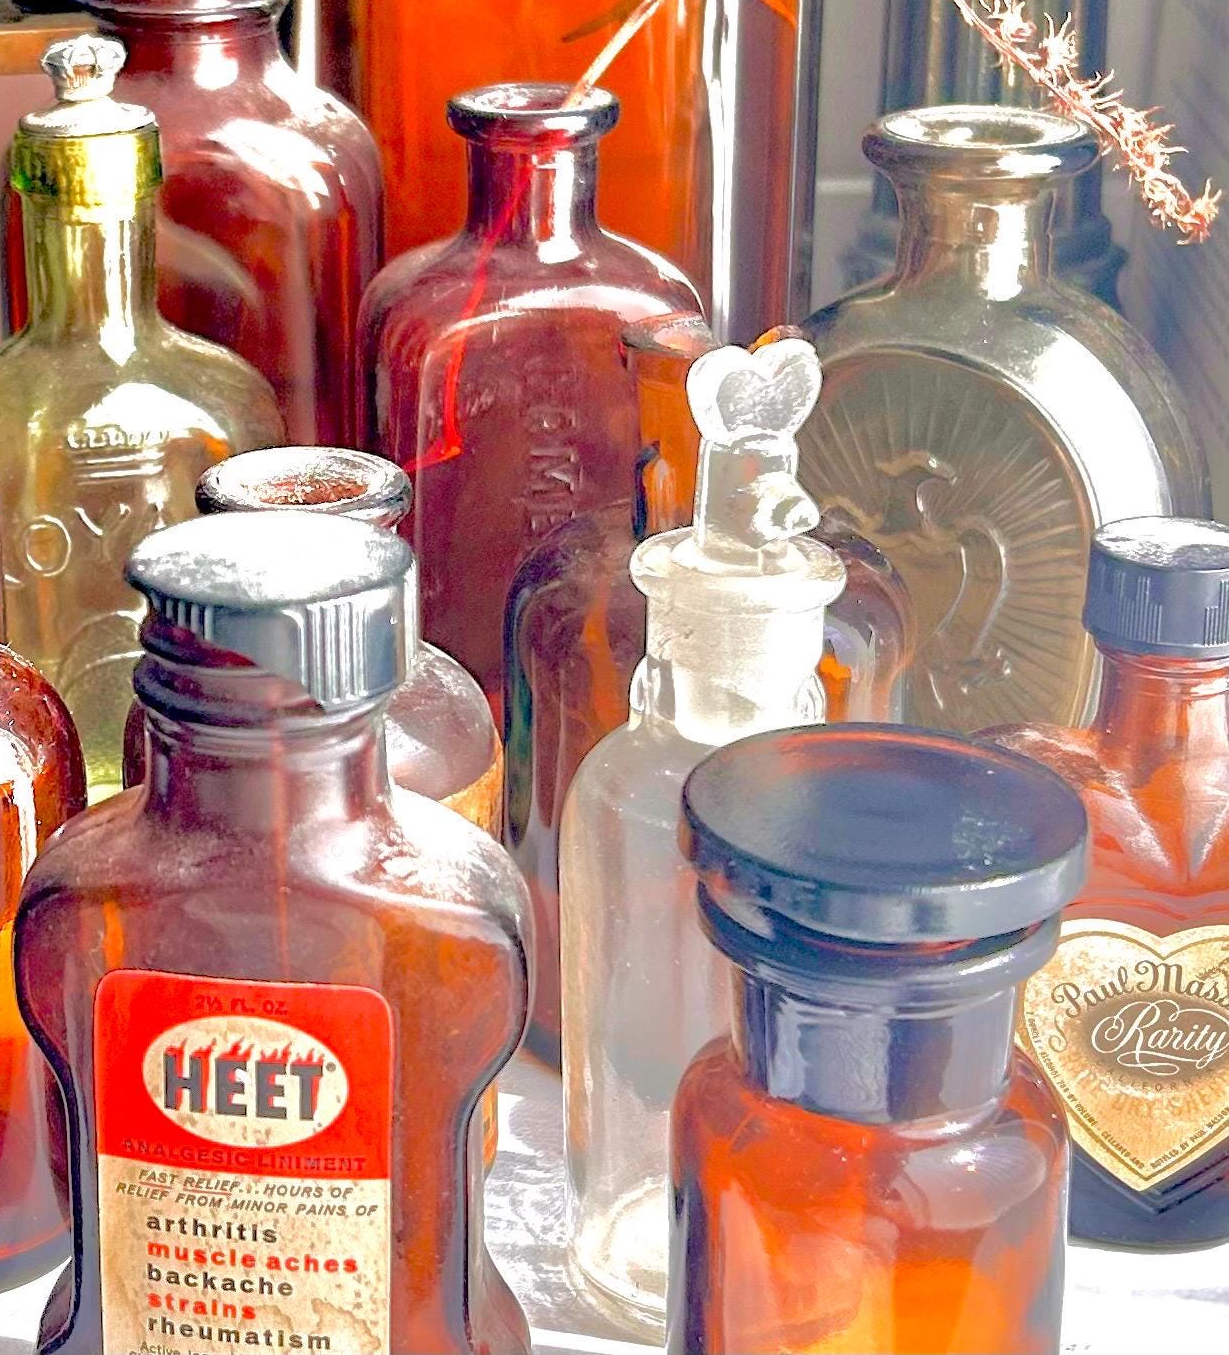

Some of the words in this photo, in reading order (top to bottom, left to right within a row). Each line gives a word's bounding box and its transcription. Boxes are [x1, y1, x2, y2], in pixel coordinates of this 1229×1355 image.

[1051, 966, 1135, 1018] Paul
[1091, 999, 1229, 1076] Rarity
[163, 1042, 324, 1122] HEET
[1074, 1103, 1098, 1127] VOLUME
[257, 1153, 367, 1172] LINIMENT
[116, 1182, 170, 1201] RELIEF
[175, 1193, 223, 1210] FROM
[231, 1199, 288, 1214] MINOR
[295, 1203, 347, 1217] PAINS
[355, 1205, 378, 1217] OF
[139, 1169, 176, 1184] FAST
[263, 1184, 323, 1199] HOURS
[331, 1187, 353, 1199] OF
[147, 1215, 277, 1243] arthritis
[147, 1241, 256, 1269] muscle
[266, 1254, 358, 1273] aches
[147, 1263, 293, 1297] backache
[147, 1292, 256, 1320] strains
[148, 1316, 331, 1350] rheumatism
